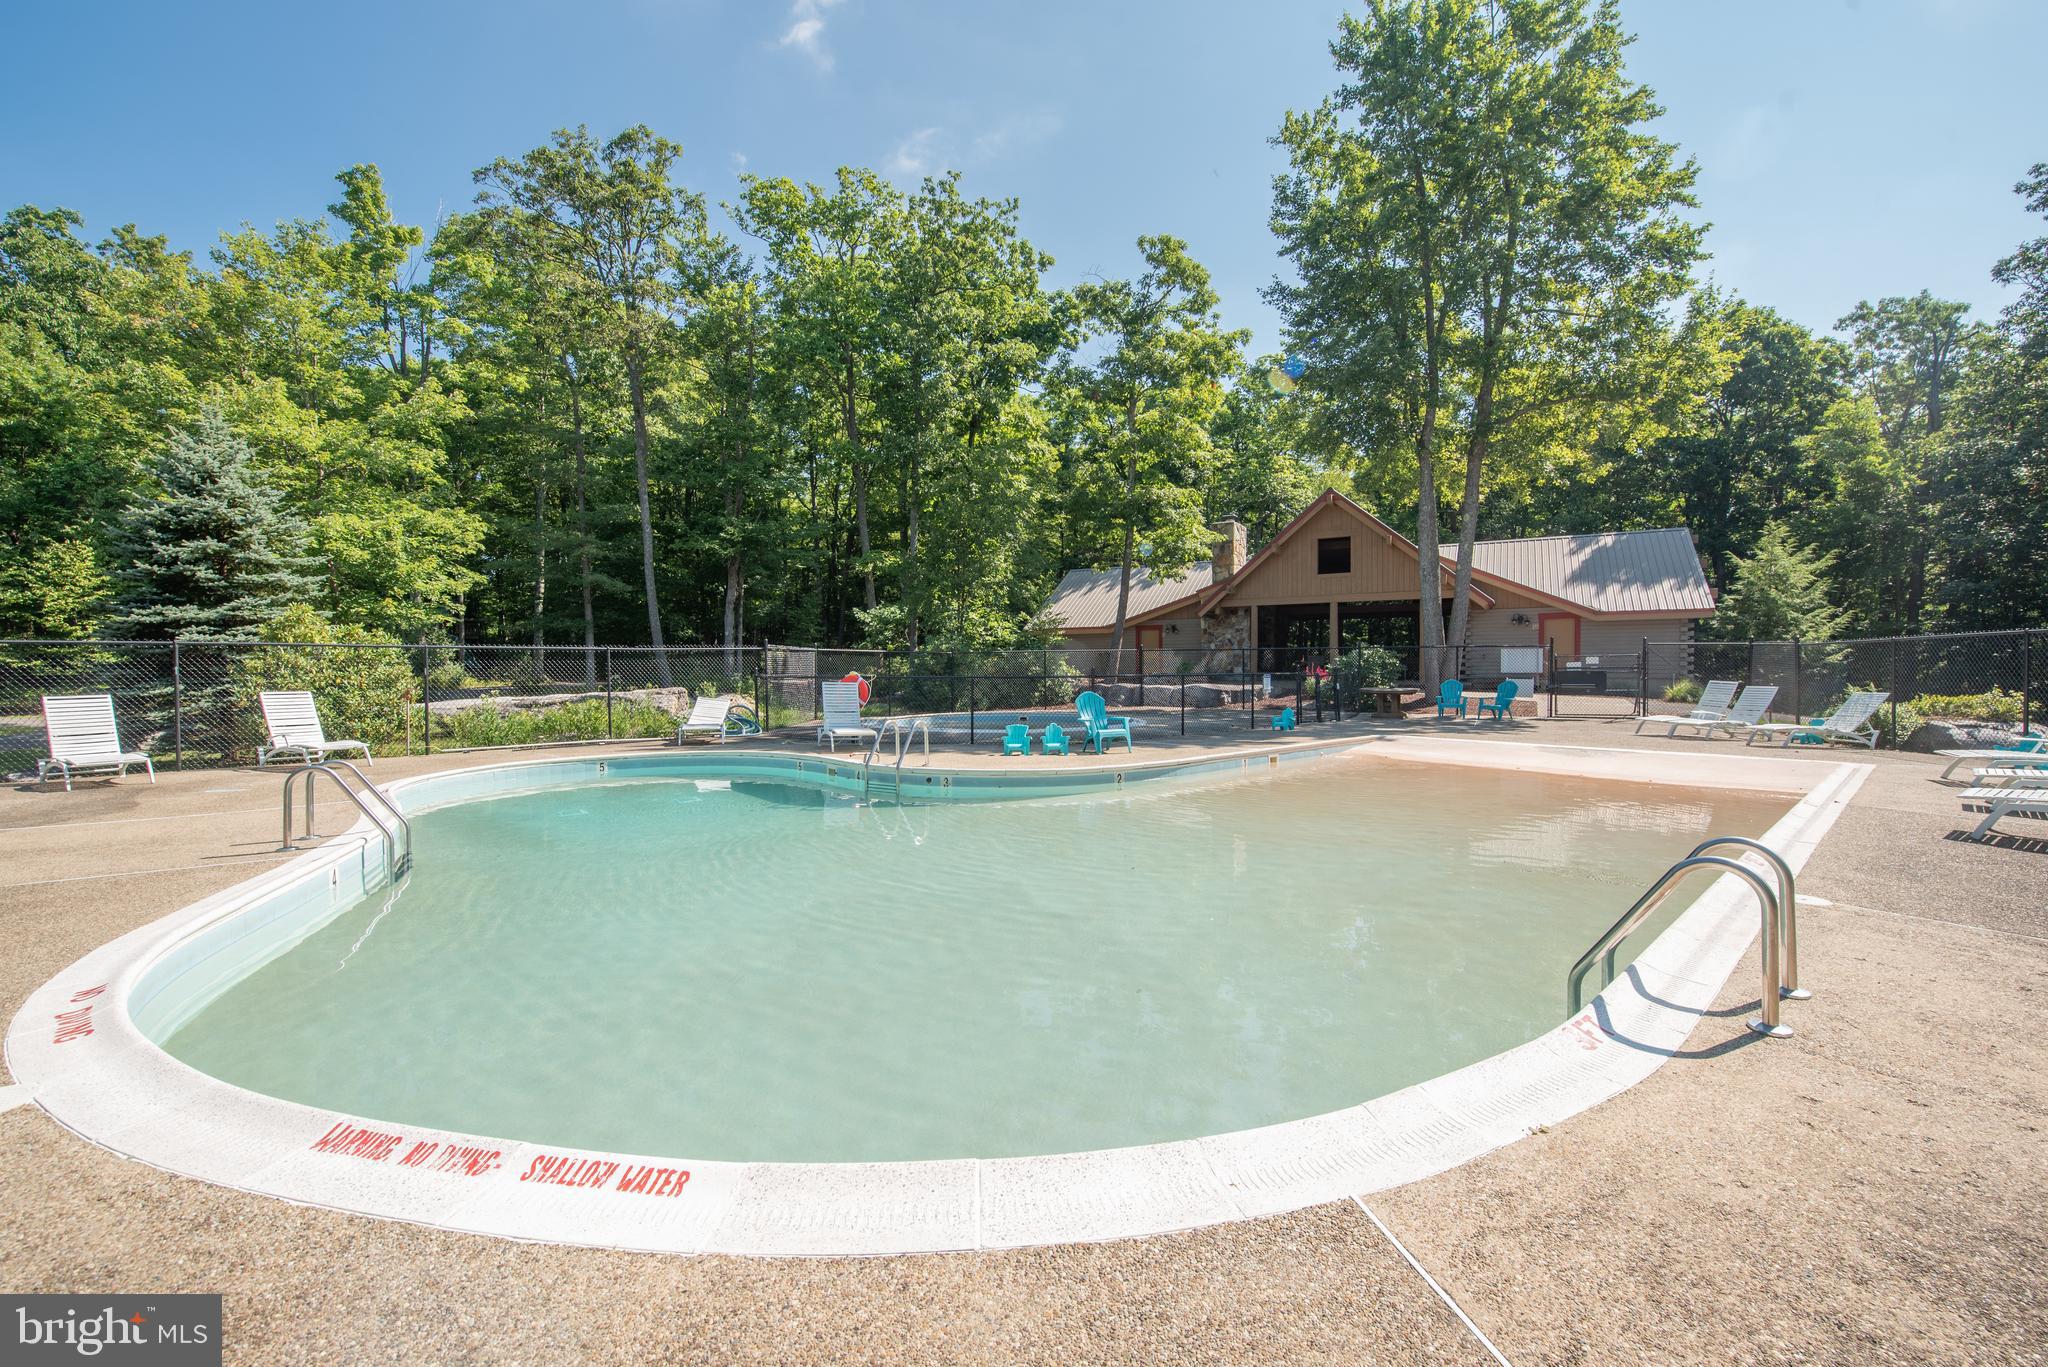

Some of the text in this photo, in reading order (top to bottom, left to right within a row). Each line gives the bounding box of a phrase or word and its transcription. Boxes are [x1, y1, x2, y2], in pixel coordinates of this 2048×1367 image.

[397, 1140, 439, 1167] NO
[520, 1154, 690, 1198] SHALLOW WATER
